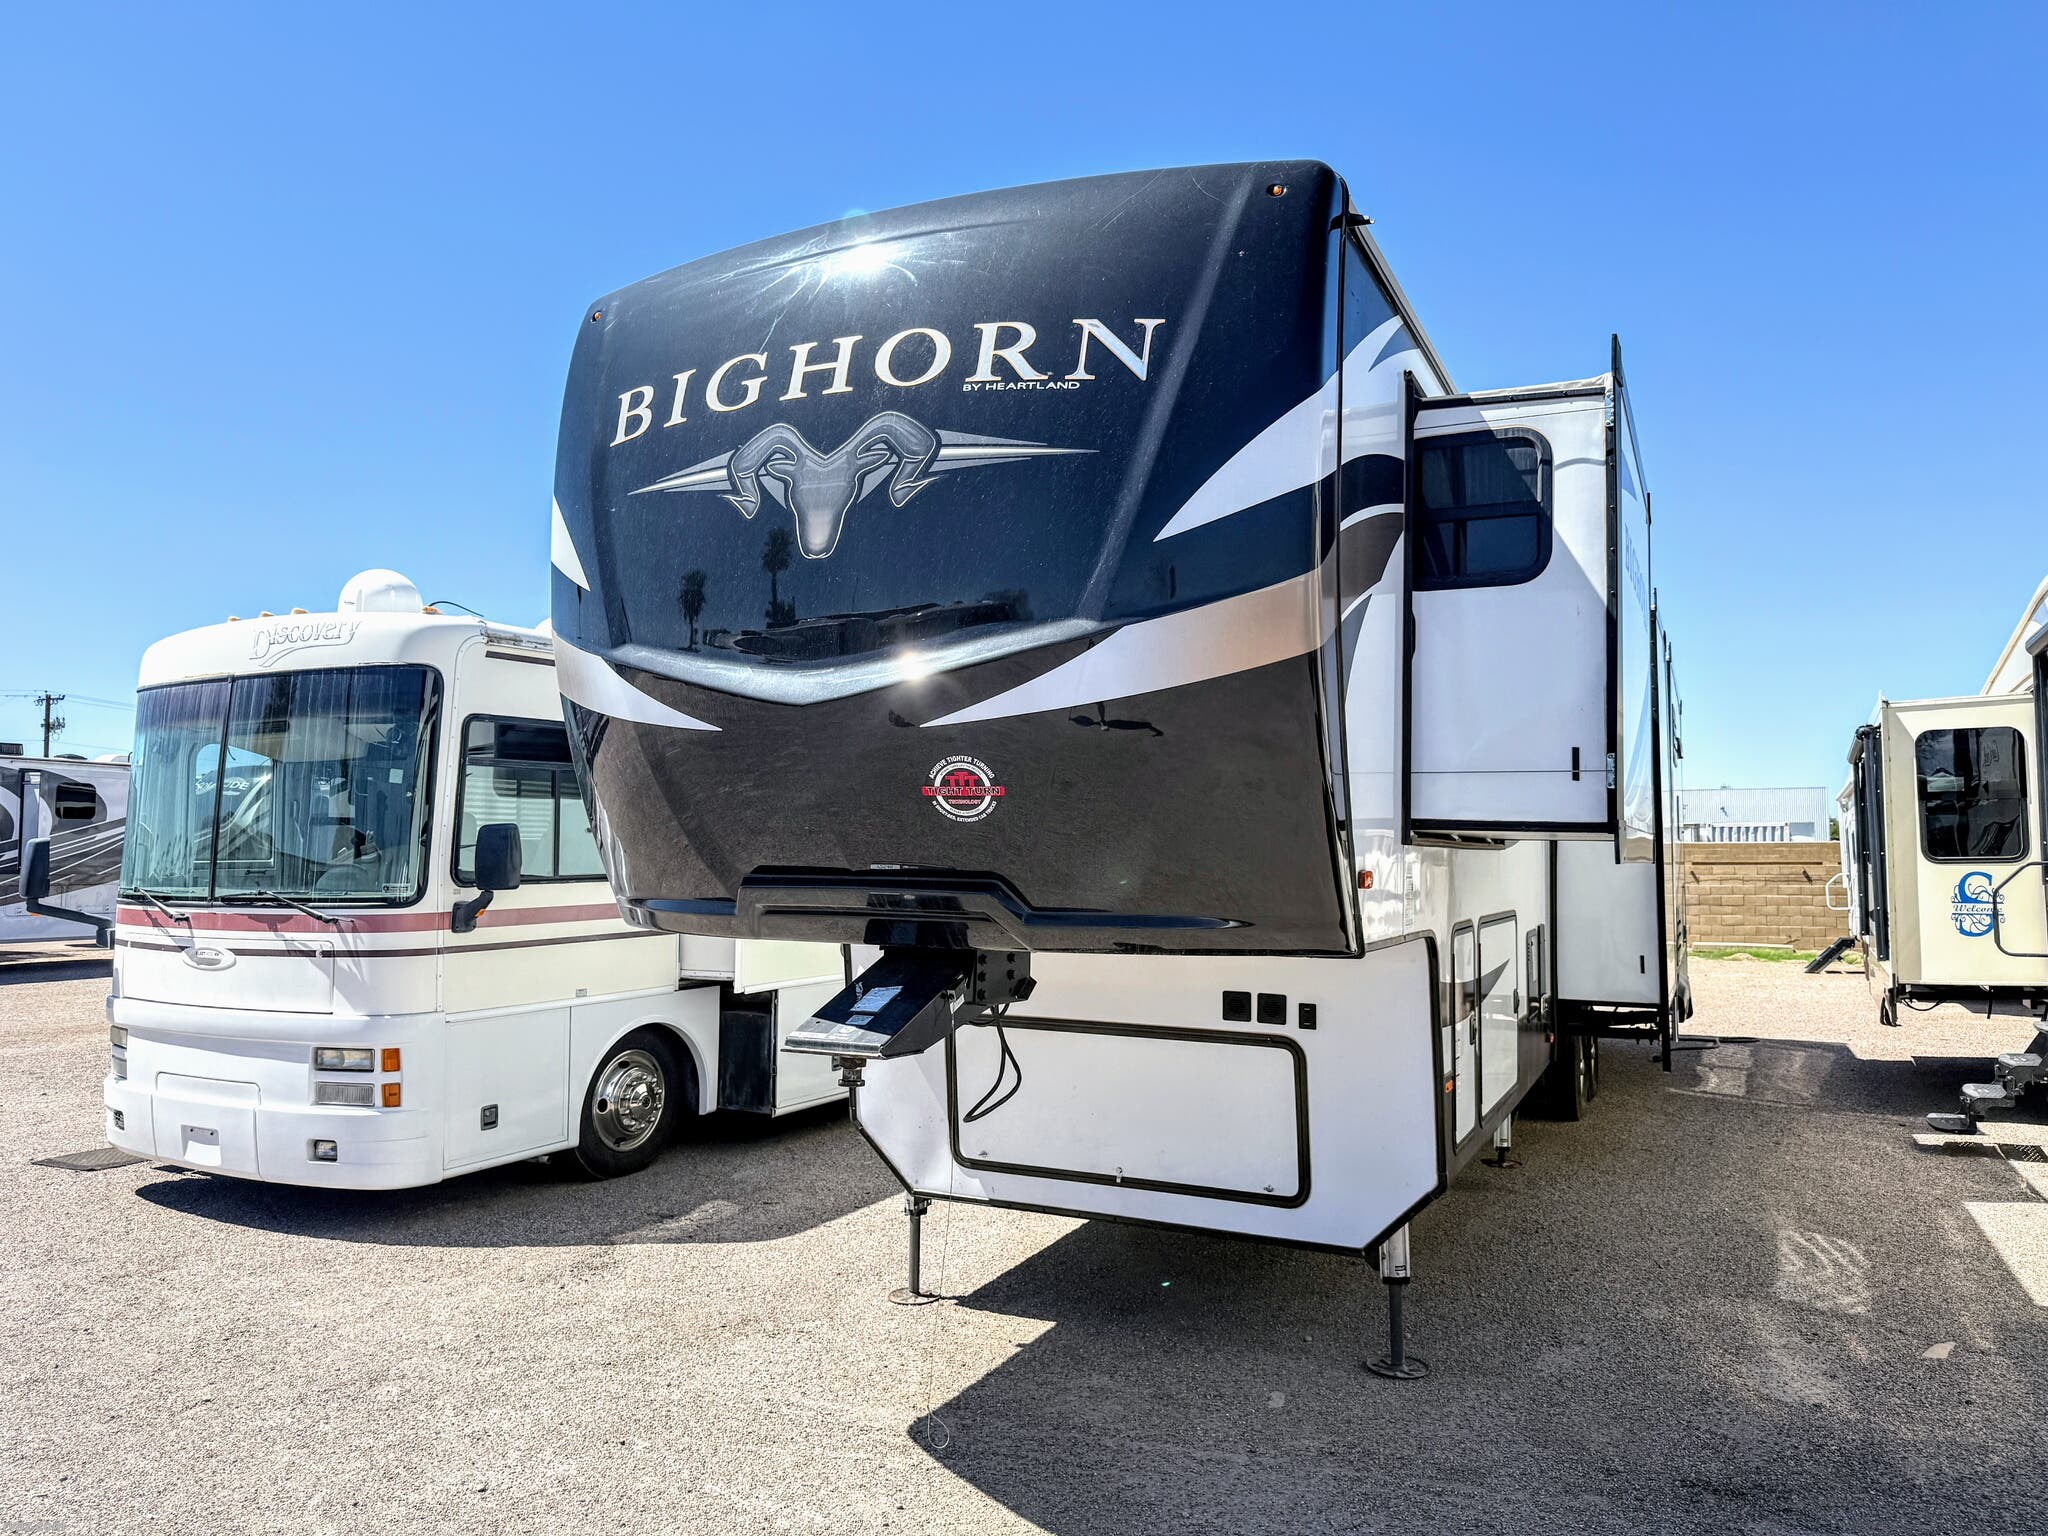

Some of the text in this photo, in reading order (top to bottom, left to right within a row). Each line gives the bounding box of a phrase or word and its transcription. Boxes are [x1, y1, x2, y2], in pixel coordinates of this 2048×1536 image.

[609, 317, 1166, 448] BIGHORN
[962, 380, 1081, 392] BY HEARTLAND
[248, 620, 361, 666] Discovery
[928, 758, 948, 779] ACHIEVE
[946, 755, 972, 763] TIGHTER
[973, 758, 995, 779] TURNING
[926, 786, 1001, 796] TIGHT TURN
